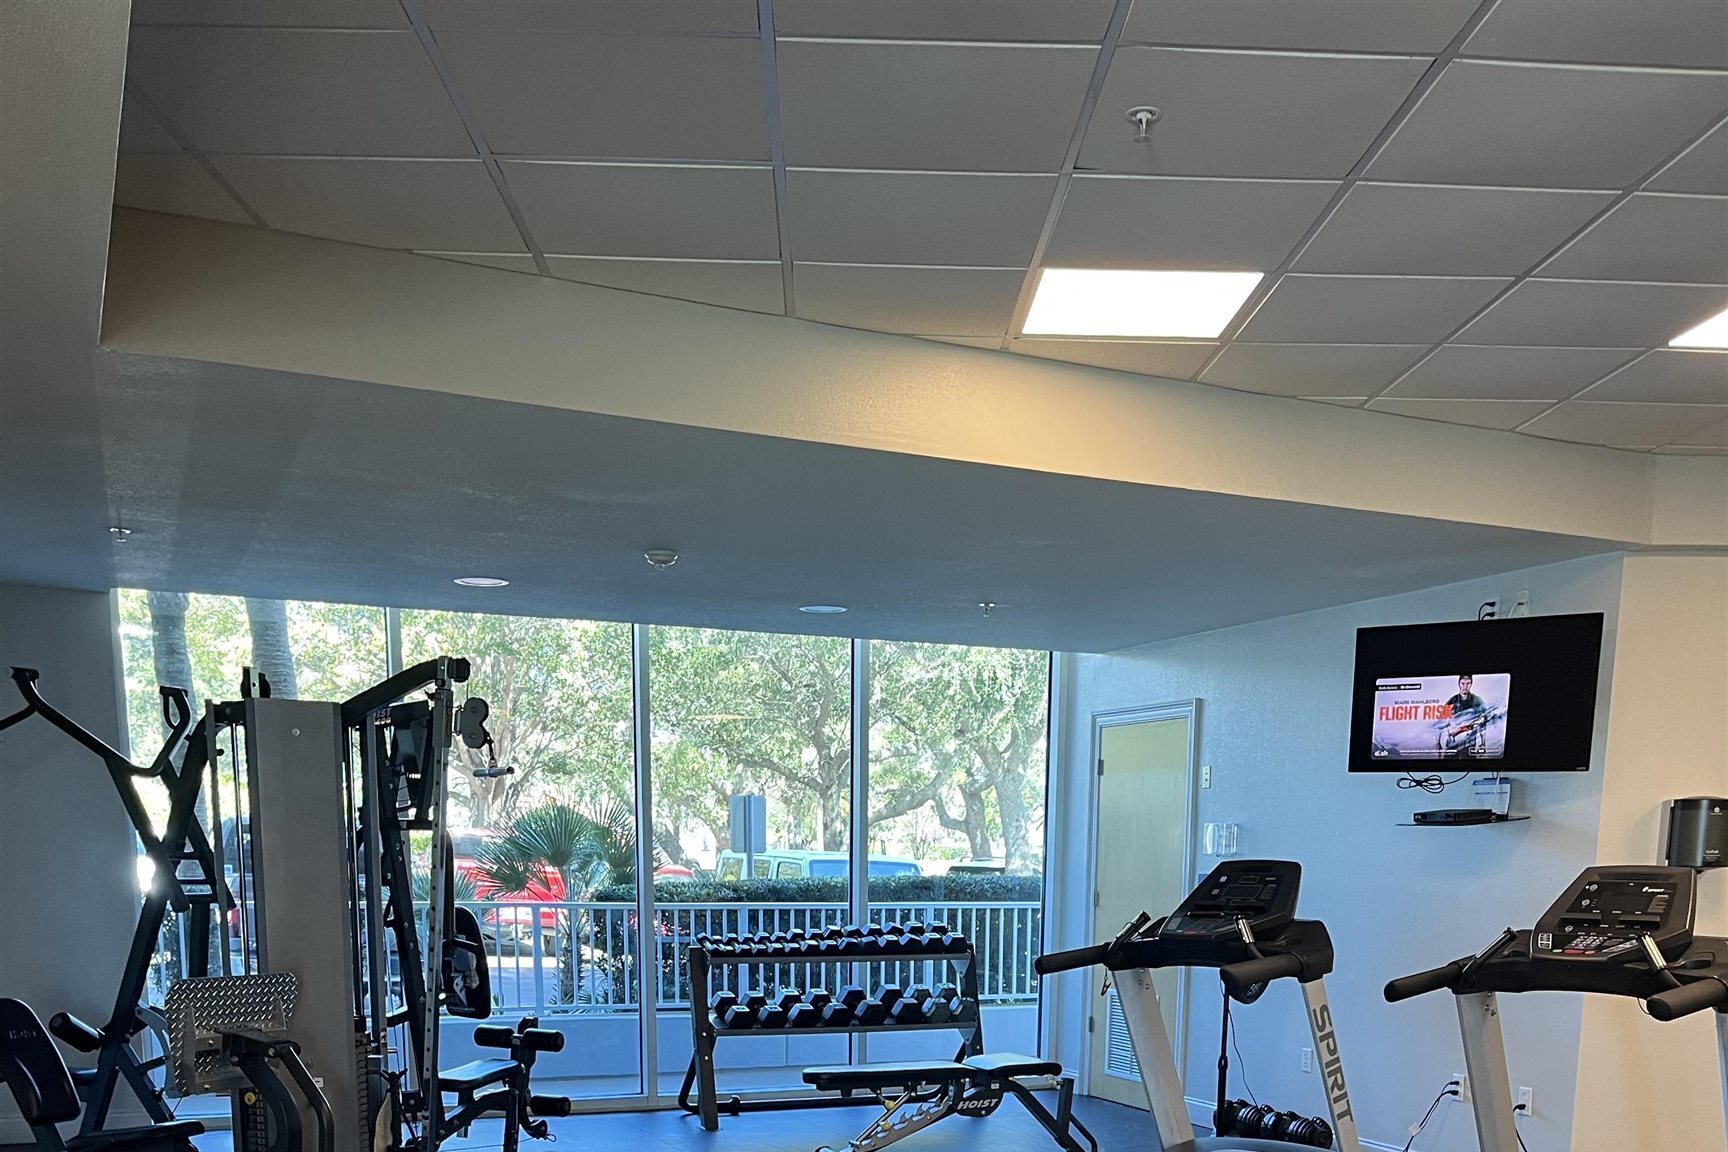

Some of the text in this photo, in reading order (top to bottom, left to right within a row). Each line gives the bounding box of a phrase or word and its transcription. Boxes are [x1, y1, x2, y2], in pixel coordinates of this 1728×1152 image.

[1379, 705, 1420, 721] FLIGHT
[1313, 1003, 1354, 1123] SPIRIT
[957, 1098, 999, 1110] HOIST
